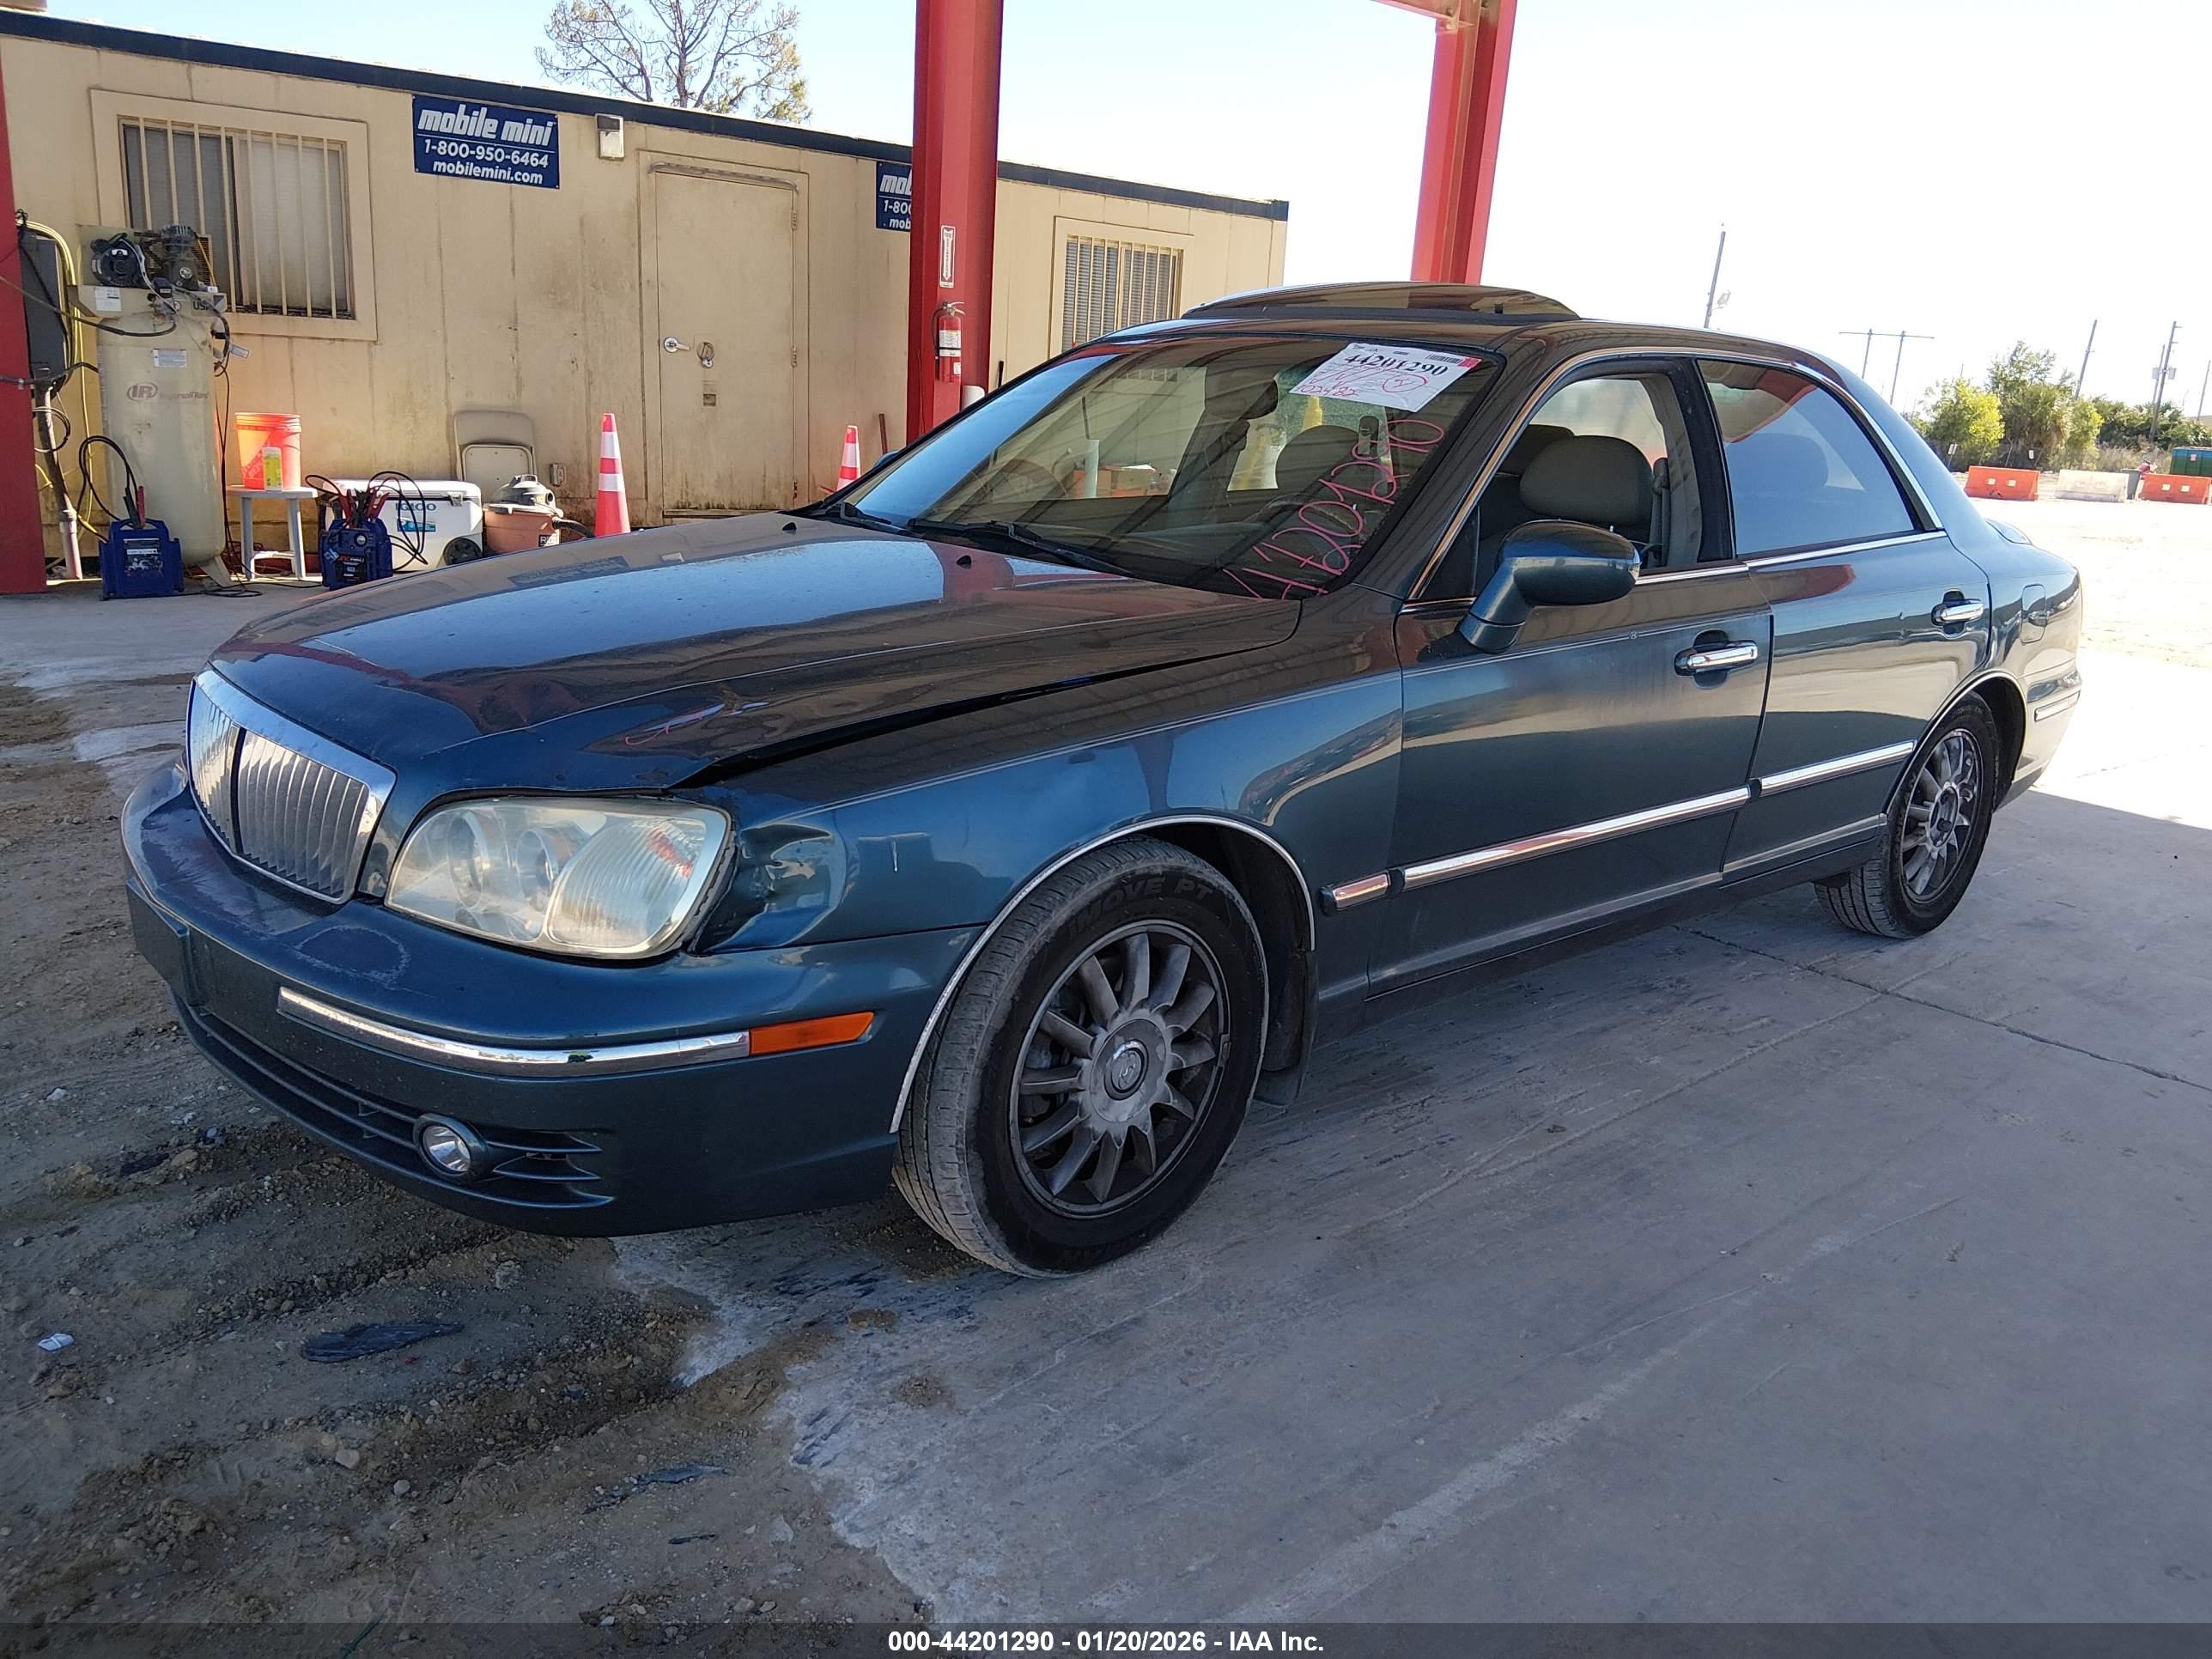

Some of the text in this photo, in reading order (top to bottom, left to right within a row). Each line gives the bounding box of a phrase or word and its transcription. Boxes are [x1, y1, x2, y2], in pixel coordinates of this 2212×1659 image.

[417, 104, 554, 146] mobile mini
[424, 139, 549, 168] 1-800-950-6464
[433, 161, 543, 185] mobilemini.com
[1345, 353, 1449, 376] 44201290
[1174, 878, 1213, 900] PT
